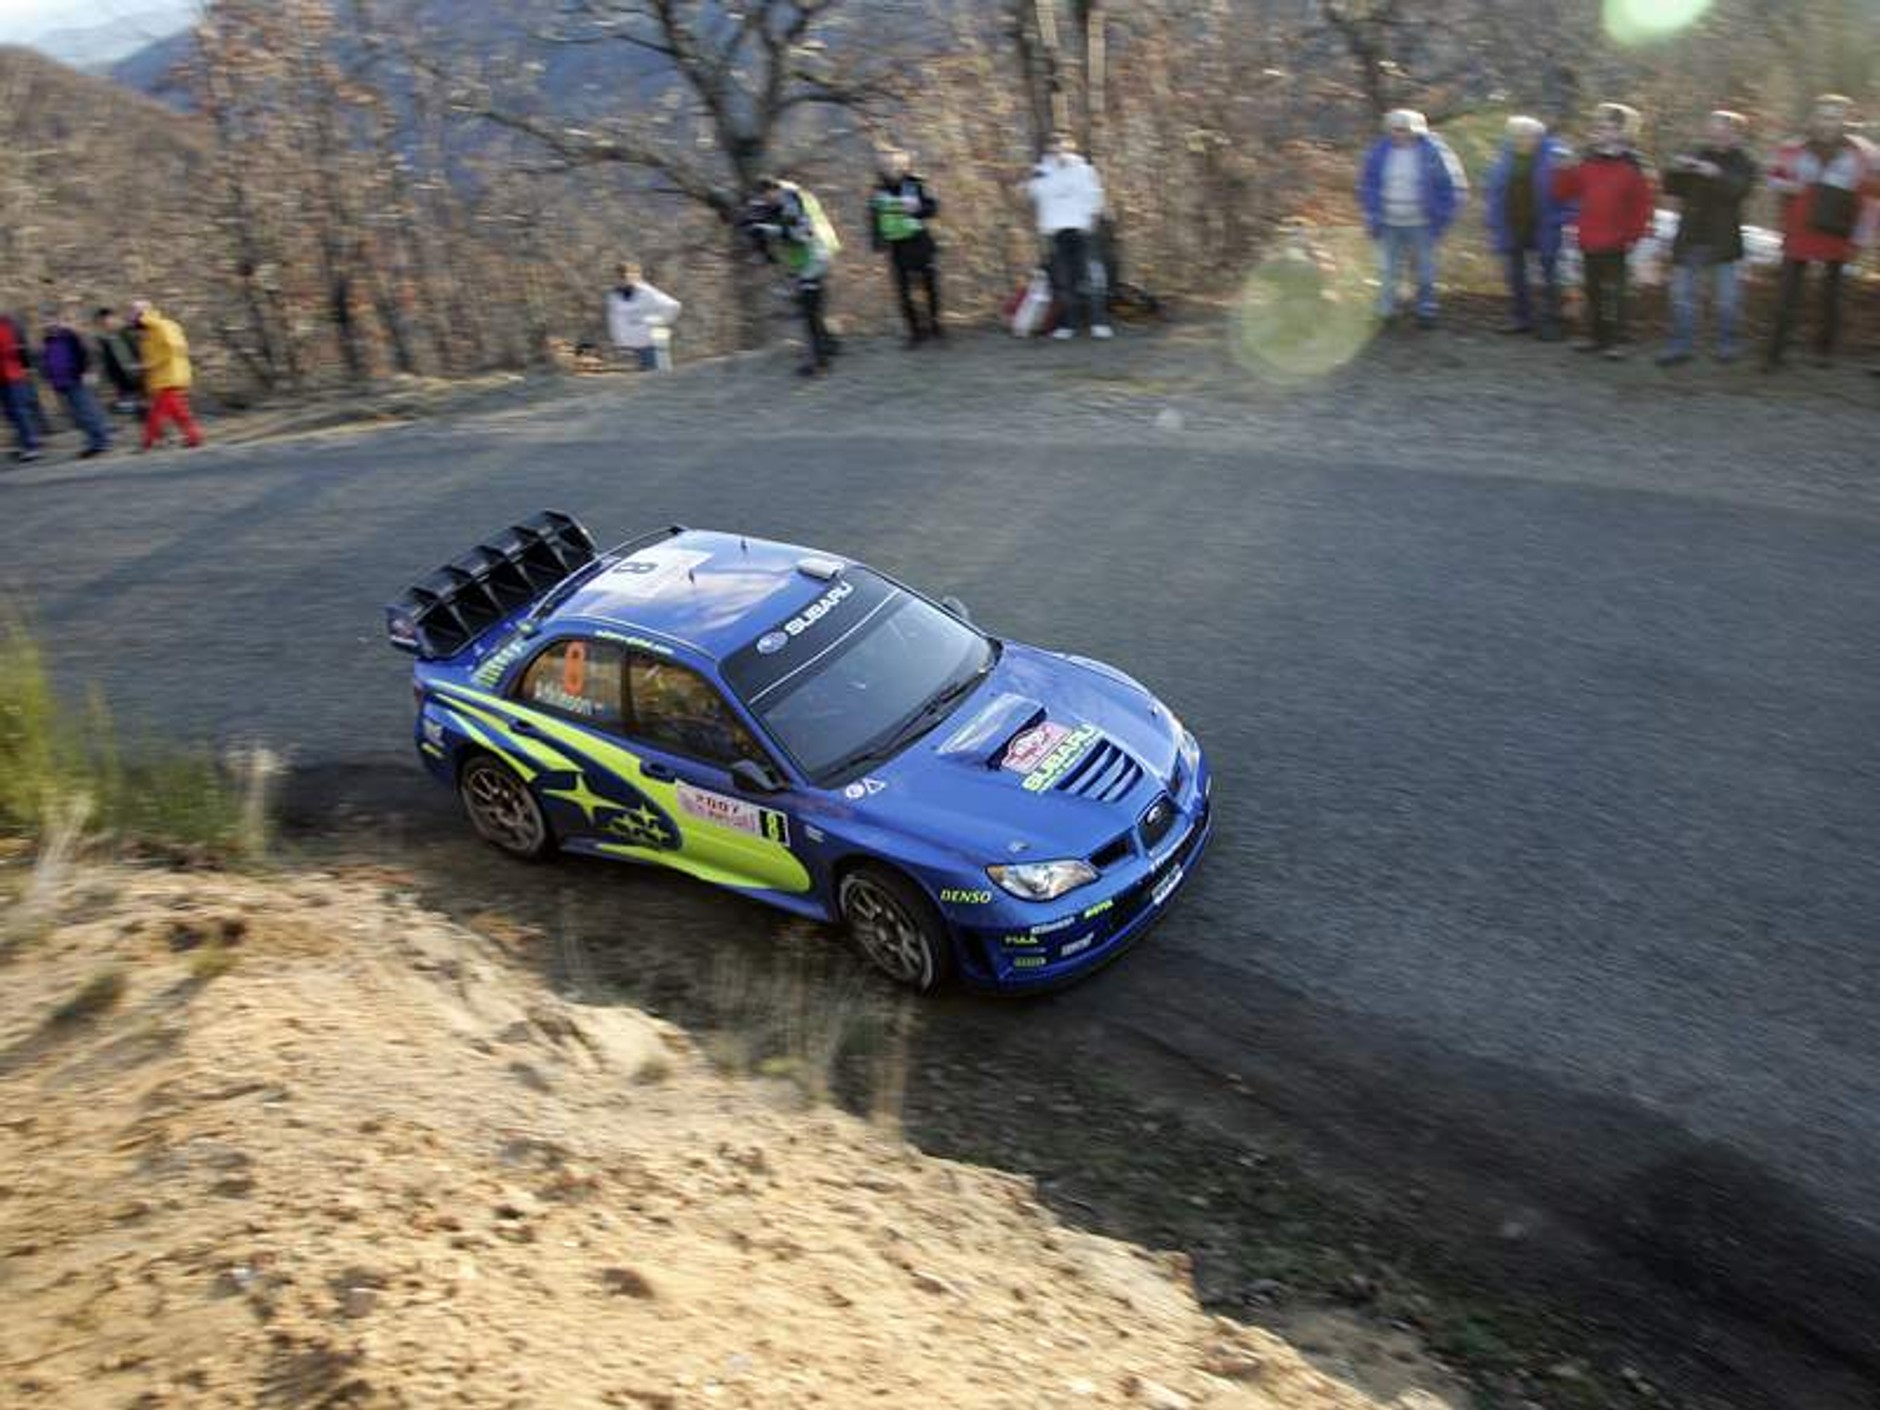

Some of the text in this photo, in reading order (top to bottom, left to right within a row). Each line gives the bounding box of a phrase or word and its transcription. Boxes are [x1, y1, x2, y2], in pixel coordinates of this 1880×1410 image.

[784, 580, 854, 636] SUBARU
[563, 640, 585, 696] 8
[1021, 723, 1096, 793] SUBARU
[766, 811, 779, 842] 8
[940, 887, 992, 904] DENSO
